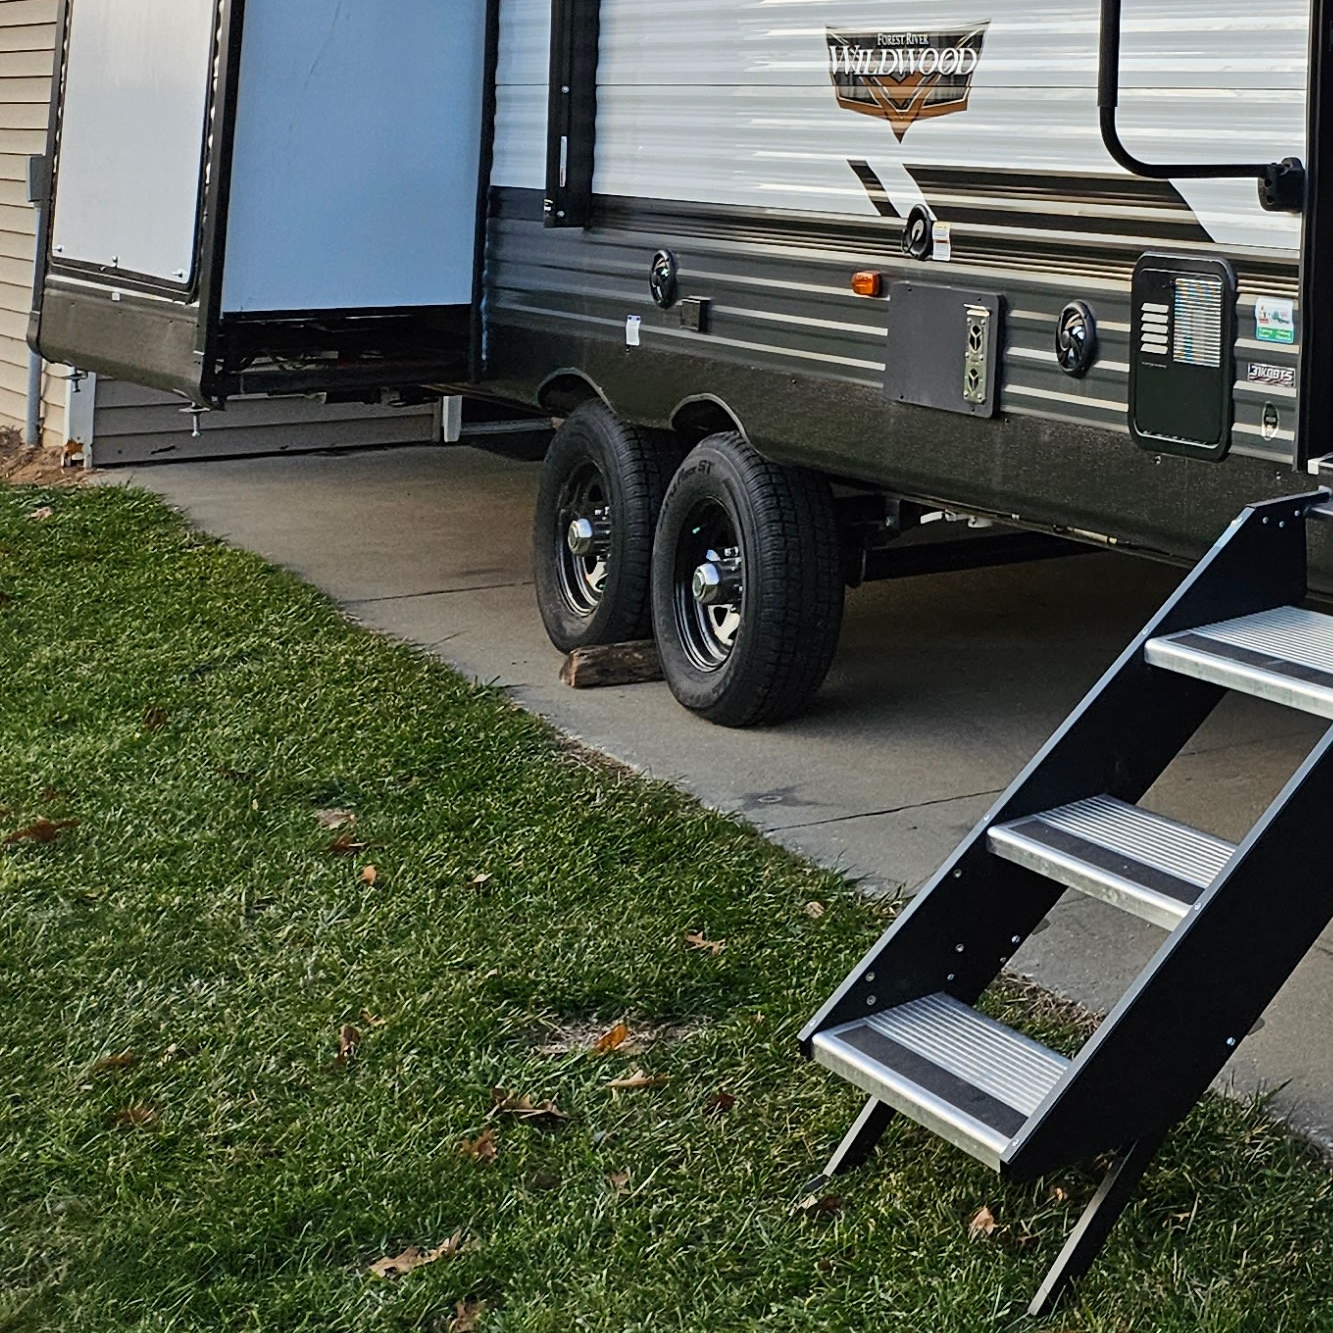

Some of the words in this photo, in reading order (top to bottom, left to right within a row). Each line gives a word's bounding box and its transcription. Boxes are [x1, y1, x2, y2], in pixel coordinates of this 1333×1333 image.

[877, 32, 906, 46] FOREST
[906, 32, 930, 46] RIVER
[828, 44, 978, 76] WILDWOOD
